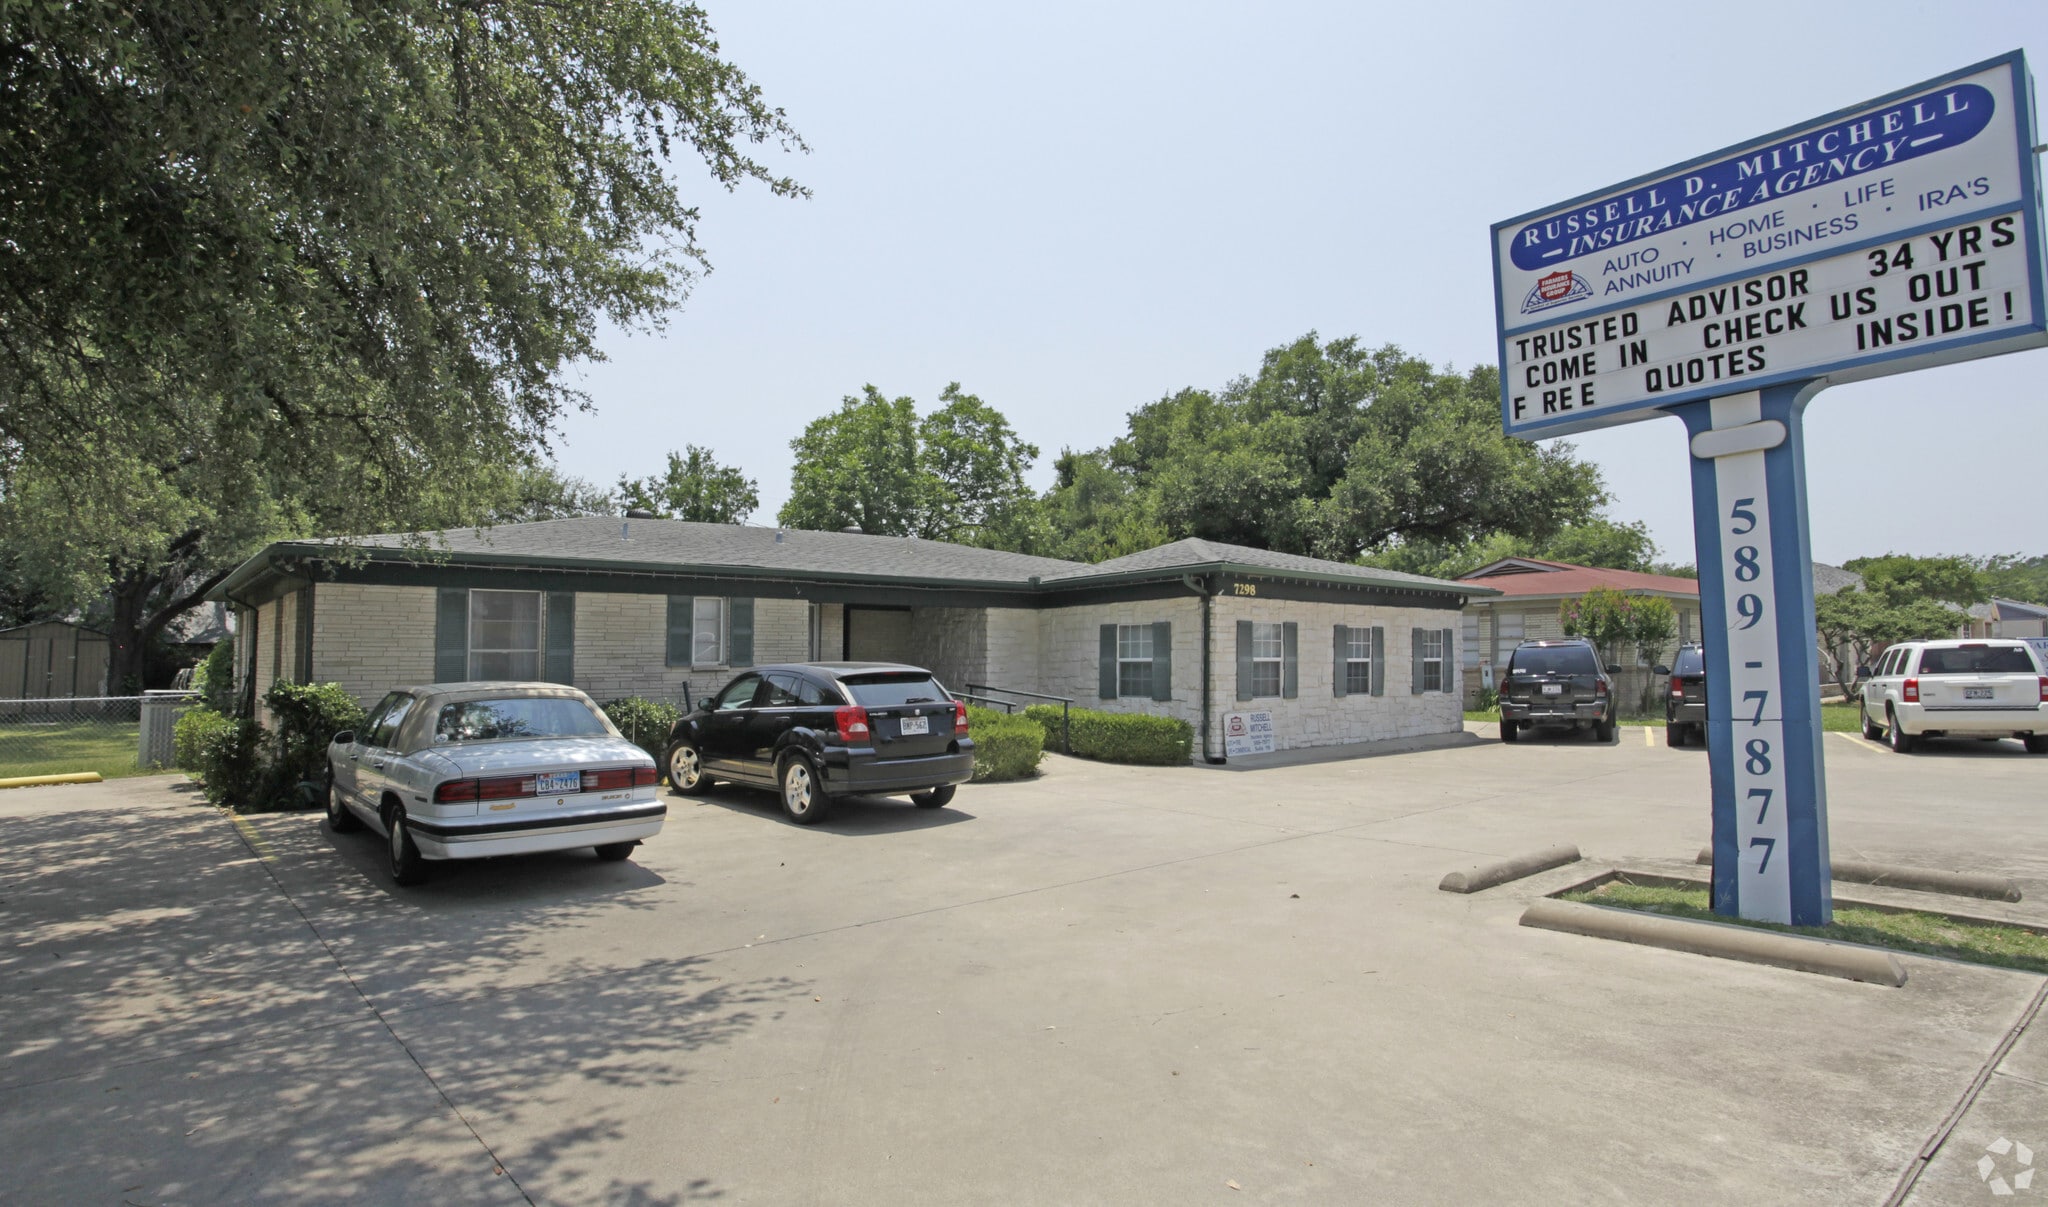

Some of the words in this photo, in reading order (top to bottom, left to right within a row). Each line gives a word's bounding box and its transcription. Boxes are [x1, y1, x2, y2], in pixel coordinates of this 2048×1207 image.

[1524, 190, 1666, 248] RUSSELL
[1684, 177, 1717, 199] D.
[1738, 92, 1970, 180] MITCHELL
[1568, 186, 1743, 257] INSURANCE
[1750, 137, 1908, 205] AGENCY
[1542, 274, 1568, 286] FARMERS
[1602, 247, 1660, 276] AUTO
[1709, 211, 1786, 246] HOME
[1844, 178, 1895, 208] LIFE
[1604, 257, 1695, 296] ANNUITY
[1743, 213, 1859, 259] BUSINESS
[1919, 176, 1990, 212] IRA'S
[1516, 311, 1638, 362] TRUSTED
[1667, 268, 1809, 327] ADVISOR
[1868, 242, 1914, 278] 34
[1929, 216, 2016, 265] YRS
[1526, 352, 1597, 389] COME
[1620, 339, 1648, 368] IN
[1704, 301, 1808, 349] CHECK
[1830, 287, 1877, 321] US
[1909, 260, 1987, 303] OUT
[1546, 287, 1566, 298] GROUP
[1645, 344, 1766, 393] QUOTES
[1234, 583, 1256, 596] 7298
